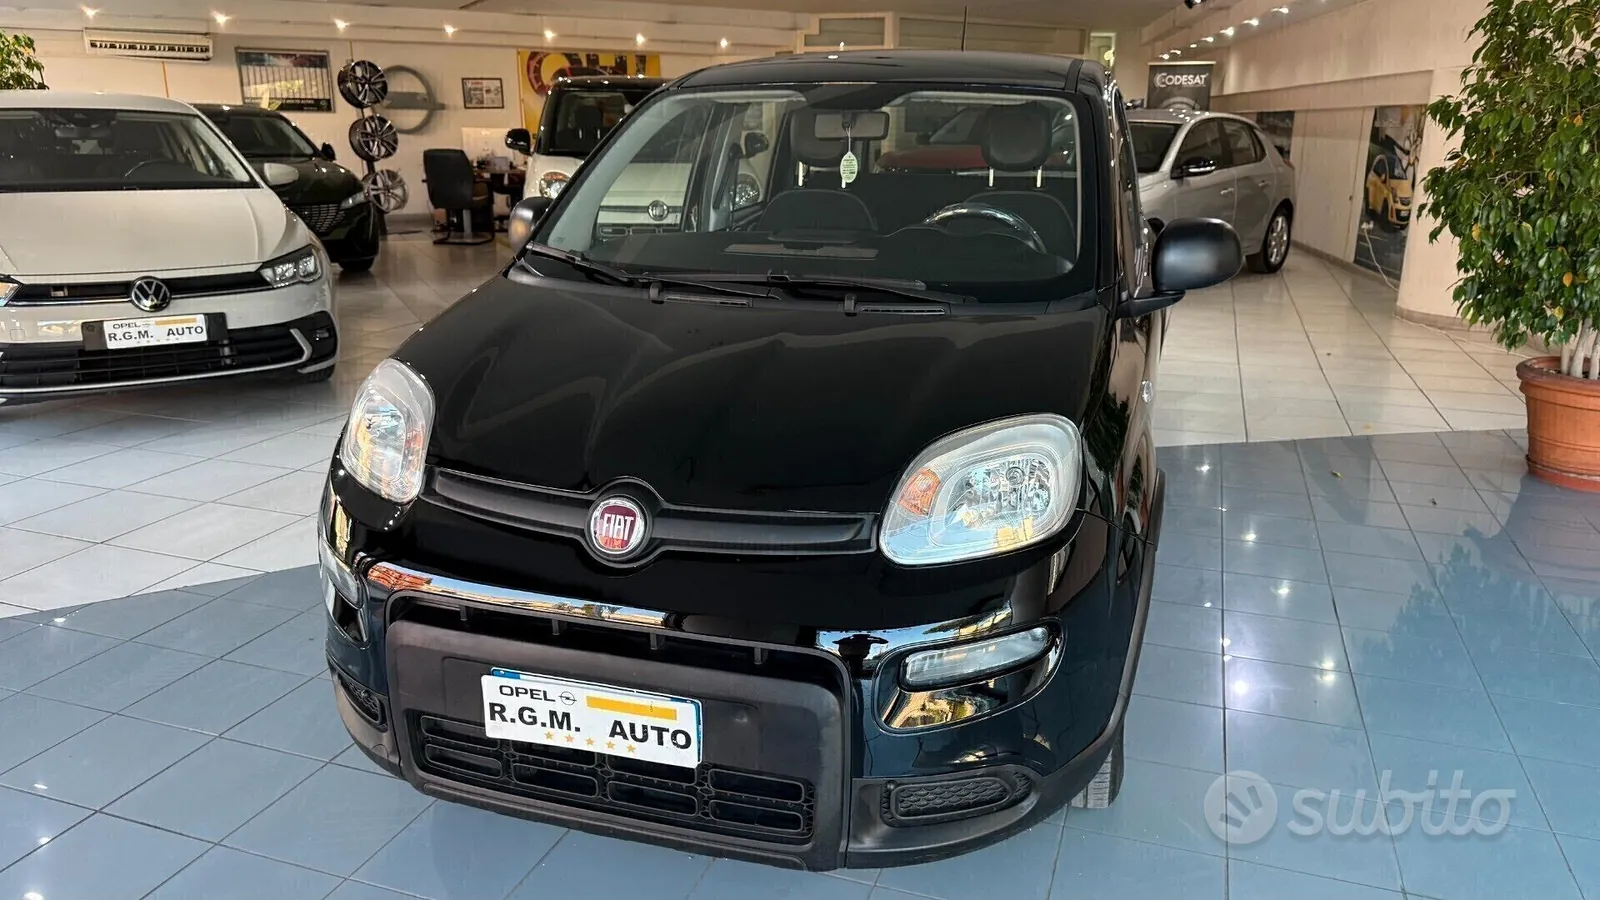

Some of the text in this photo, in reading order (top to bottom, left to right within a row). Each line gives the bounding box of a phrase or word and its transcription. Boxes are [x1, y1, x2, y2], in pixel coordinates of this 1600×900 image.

[1154, 72, 1209, 88] CODESAT
[107, 325, 204, 342] R.G.M. AUTO
[112, 322, 141, 330] OPEL
[602, 513, 635, 541] FIAT
[499, 684, 556, 702] OPEL
[488, 702, 692, 750] R.G.M. AUTO
